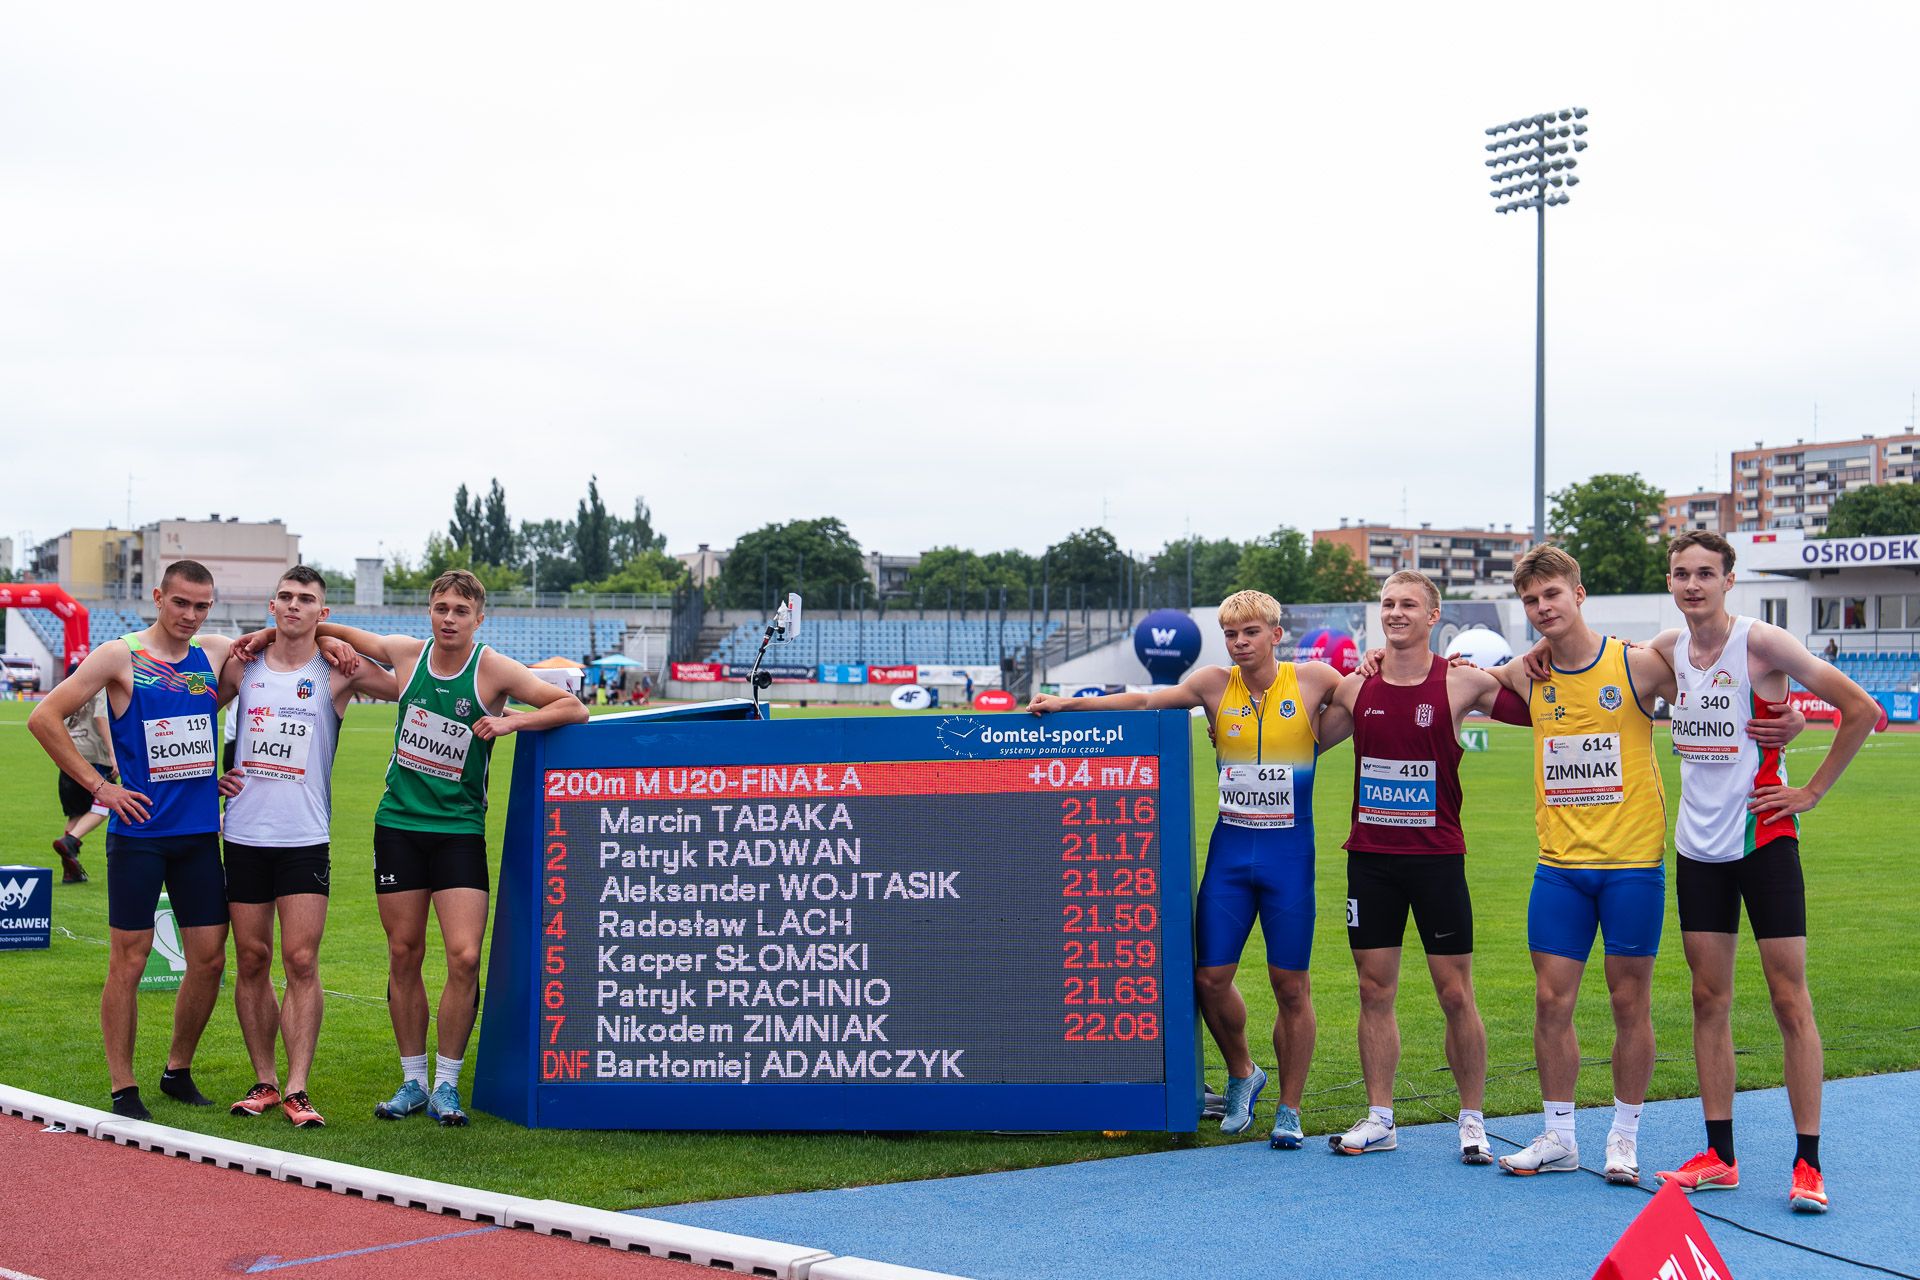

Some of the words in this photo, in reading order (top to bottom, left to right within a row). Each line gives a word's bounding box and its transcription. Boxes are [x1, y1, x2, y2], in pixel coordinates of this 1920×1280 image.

[1802, 539, 1919, 563] OŚRODEK
[248, 706, 274, 717] MKL
[1700, 696, 1730, 710] 340
[187, 718, 207, 731] 119
[280, 722, 306, 736] 113
[411, 719, 427, 728] ORLEN
[441, 722, 467, 738] 137
[1672, 720, 1735, 737] PRACHNIO
[400, 728, 464, 760] RADWAN
[980, 725, 1124, 745] domtel-sport.pl
[150, 740, 212, 760] SŁOMSKI
[252, 740, 292, 758] LACH
[1000, 746, 1036, 756] systemy
[1038, 746, 1076, 756] pomiaru
[1080, 746, 1105, 756] czasu
[1582, 737, 1612, 752] 614
[158, 770, 201, 780] WŁOCŁAWEK
[398, 757, 437, 774] WŁOCŁAWEK
[437, 770, 454, 778] 2025
[1258, 768, 1286, 781] 612
[1400, 764, 1428, 777] 410
[1546, 762, 1618, 780] ZIMNIAK
[548, 772, 625, 796] 200m
[635, 770, 660, 794] M
[1028, 759, 1093, 787] +0.4
[1101, 758, 1153, 786] m/s
[1222, 791, 1290, 806] WOJTASIK
[1364, 784, 1430, 803] TABAKA
[548, 808, 567, 836] 1
[600, 807, 701, 834] Marcin
[712, 803, 853, 832] TABAKA
[1062, 796, 1156, 826] 21.16
[1230, 818, 1268, 827] WŁOCŁAWEK
[1366, 815, 1408, 824] WŁOCŁAWEK
[547, 842, 567, 870] 2
[600, 840, 698, 874] Patryk
[708, 838, 861, 867] RADWAN
[1062, 832, 1154, 860] 21.17
[546, 877, 566, 905] 3
[600, 874, 770, 903] Aleksander
[778, 871, 960, 901] WOJTASIK
[1062, 868, 1157, 896] 21.28
[0, 917, 49, 929] CŁAWEK
[546, 912, 566, 939] 4
[598, 910, 746, 938] Radosław
[757, 908, 852, 936] LACH
[1063, 904, 1157, 932] 21.50
[546, 946, 566, 974] 5
[598, 945, 707, 979] Kacper
[714, 942, 868, 972] SŁOMSKI
[1063, 940, 1156, 968] 21.59
[544, 980, 564, 1008] 6
[598, 979, 696, 1014] Patryk
[706, 978, 891, 1007] PRACHNIO
[1064, 976, 1158, 1004] 21.63
[545, 1016, 566, 1044] 7
[597, 1014, 734, 1042] Nikodem
[744, 1014, 889, 1042] ZIMNIAK
[1064, 1012, 1159, 1040] 22.08
[543, 1050, 590, 1078] DNF
[596, 1050, 751, 1084] Bartłomiej
[761, 1049, 965, 1078] ADAMCZYK
